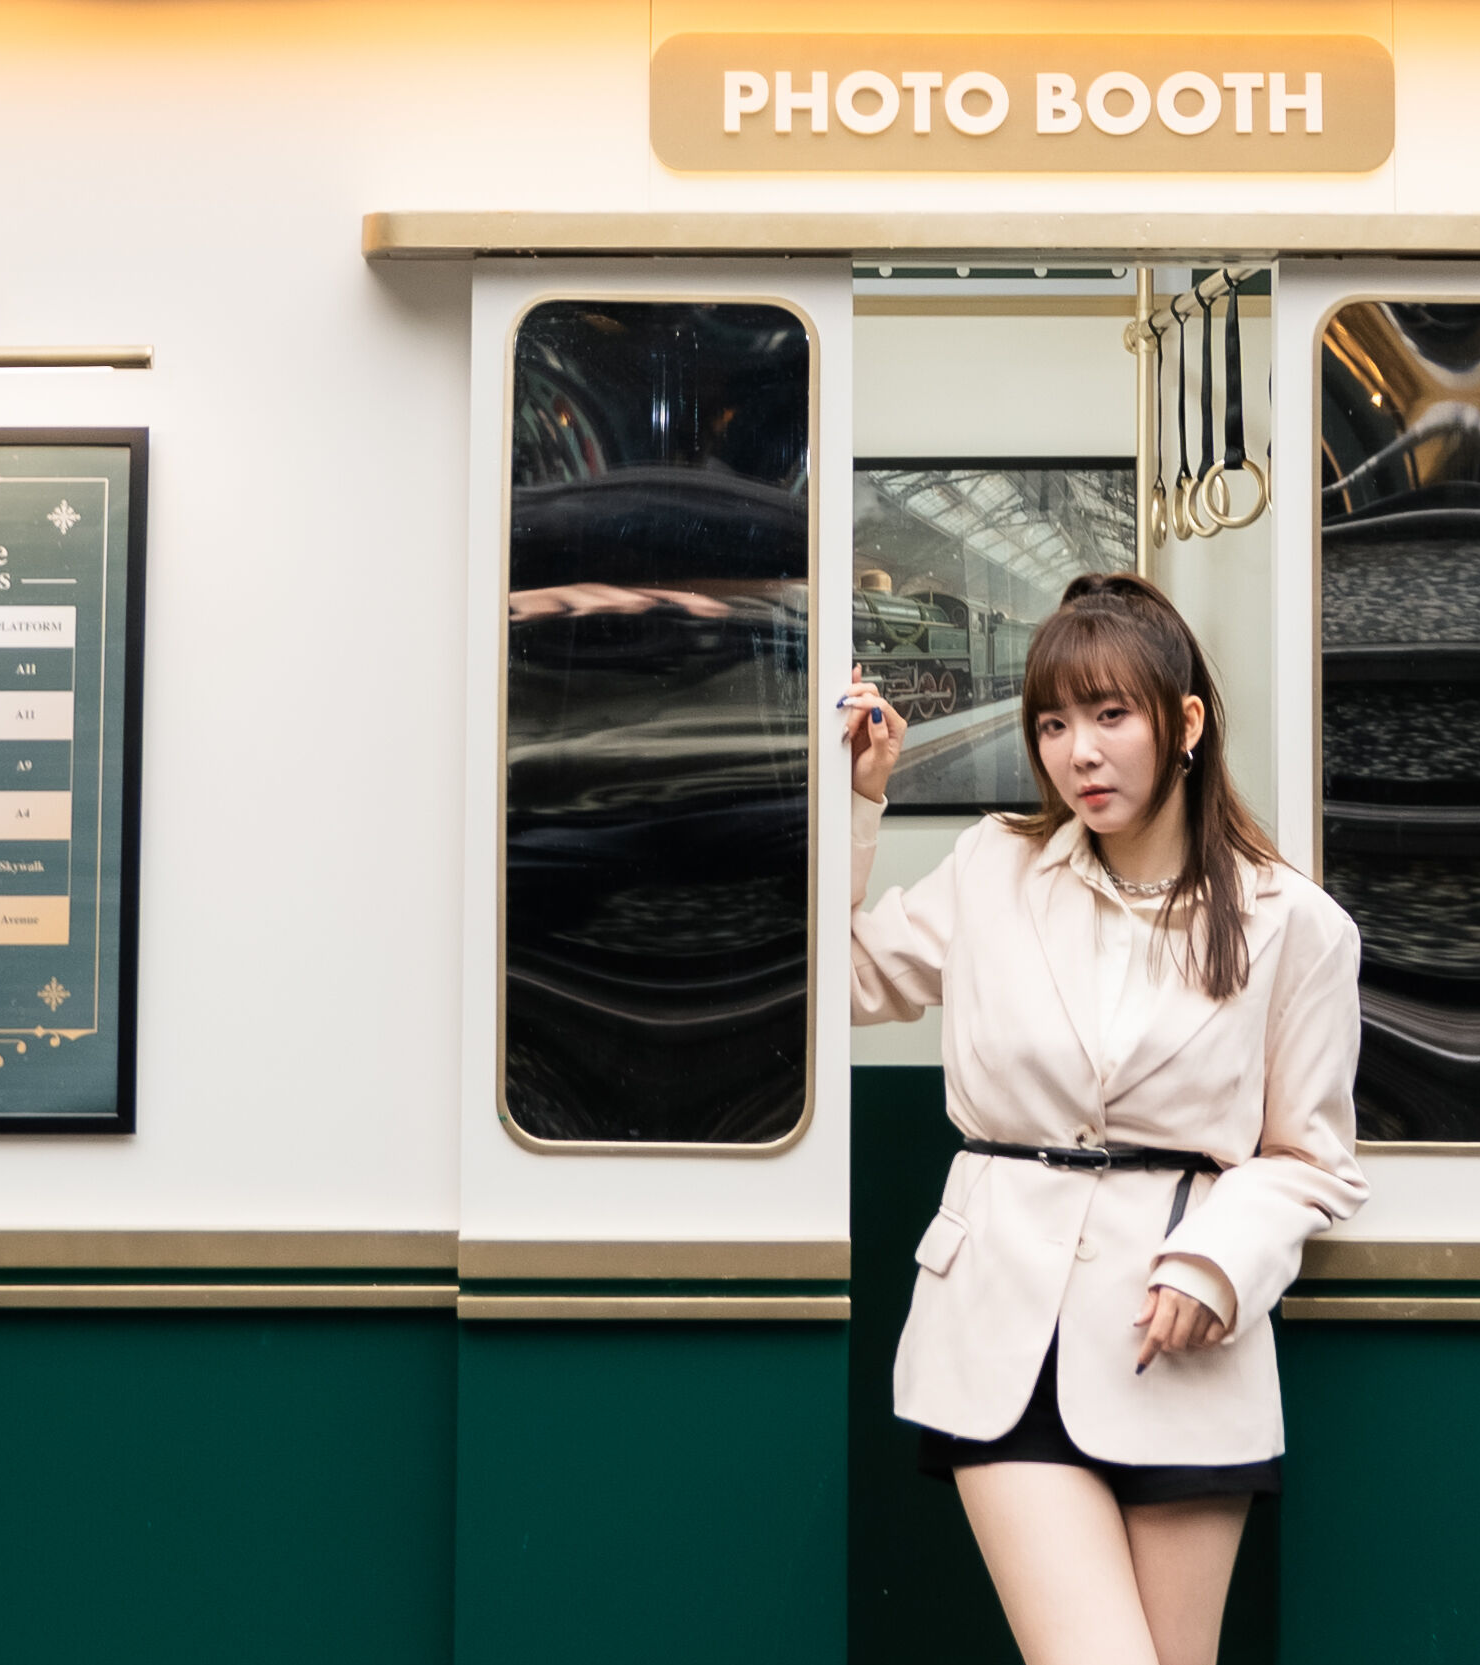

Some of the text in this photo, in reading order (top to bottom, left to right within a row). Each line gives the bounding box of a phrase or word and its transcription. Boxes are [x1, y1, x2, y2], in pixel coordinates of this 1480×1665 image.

[723, 69, 1322, 135] PHOTO BOOTH
[16, 664, 36, 675] A11
[16, 709, 35, 720] A11
[16, 760, 32, 771] A9
[15, 808, 31, 819] A4
[0, 915, 39, 925] Avenue
